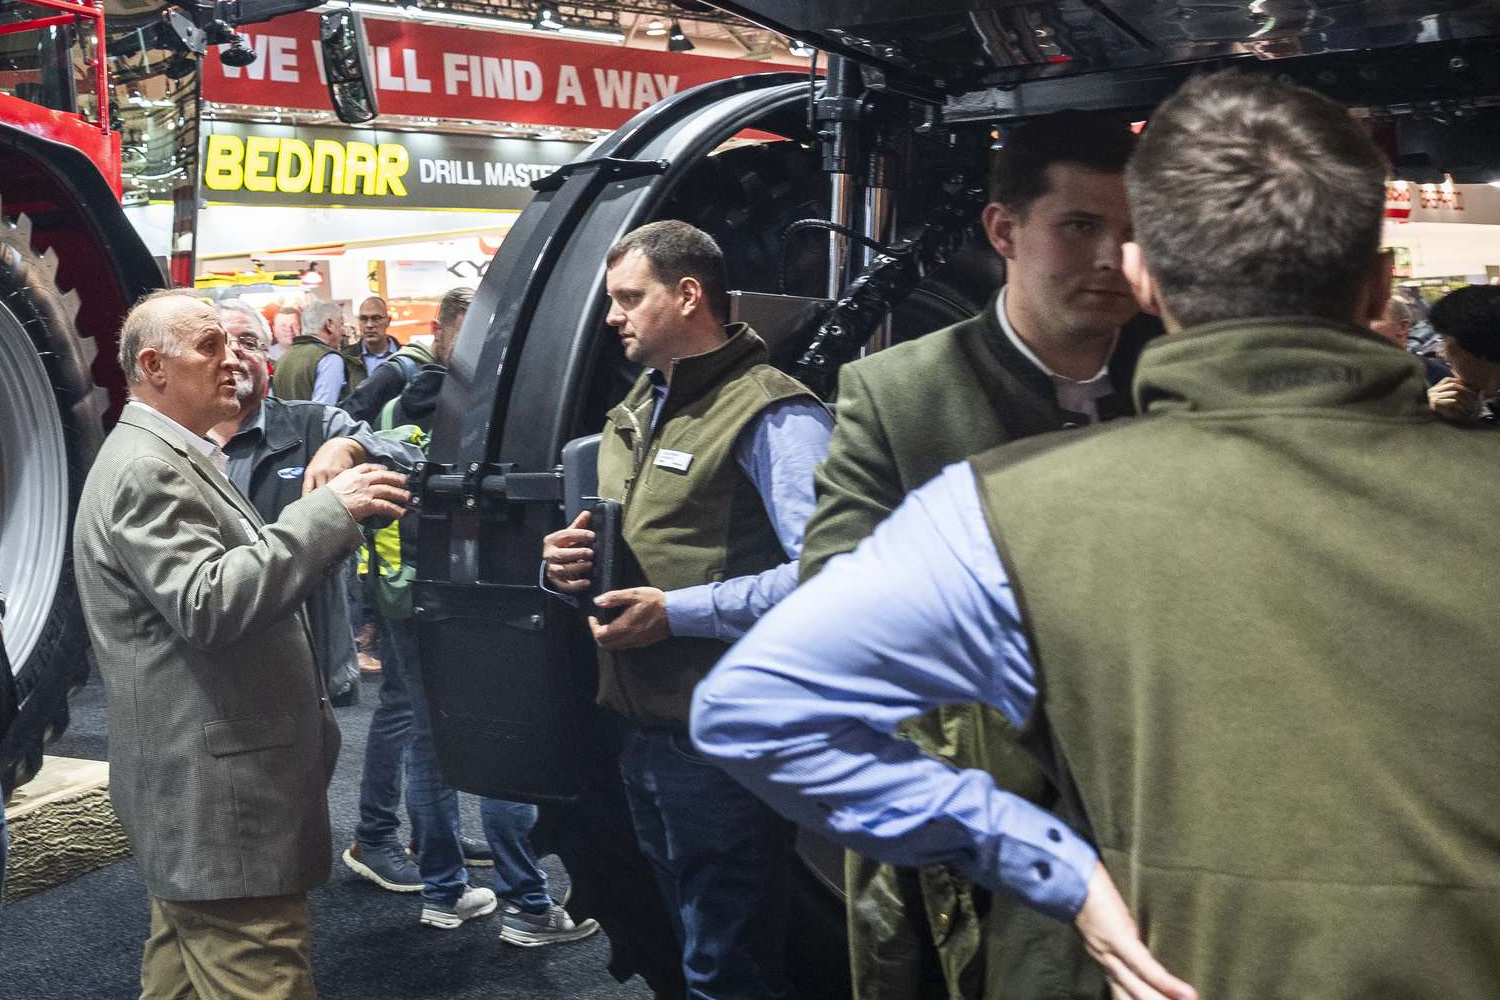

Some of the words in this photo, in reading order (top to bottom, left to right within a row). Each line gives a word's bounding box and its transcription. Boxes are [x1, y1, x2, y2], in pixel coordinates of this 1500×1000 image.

[311, 39, 432, 93] LL
[443, 52, 543, 102] FIND
[555, 65, 587, 106] A
[592, 67, 679, 110] WAY
[205, 134, 409, 196] BEDNAR
[419, 158, 481, 186] DRILL
[483, 161, 563, 188] MASTE
